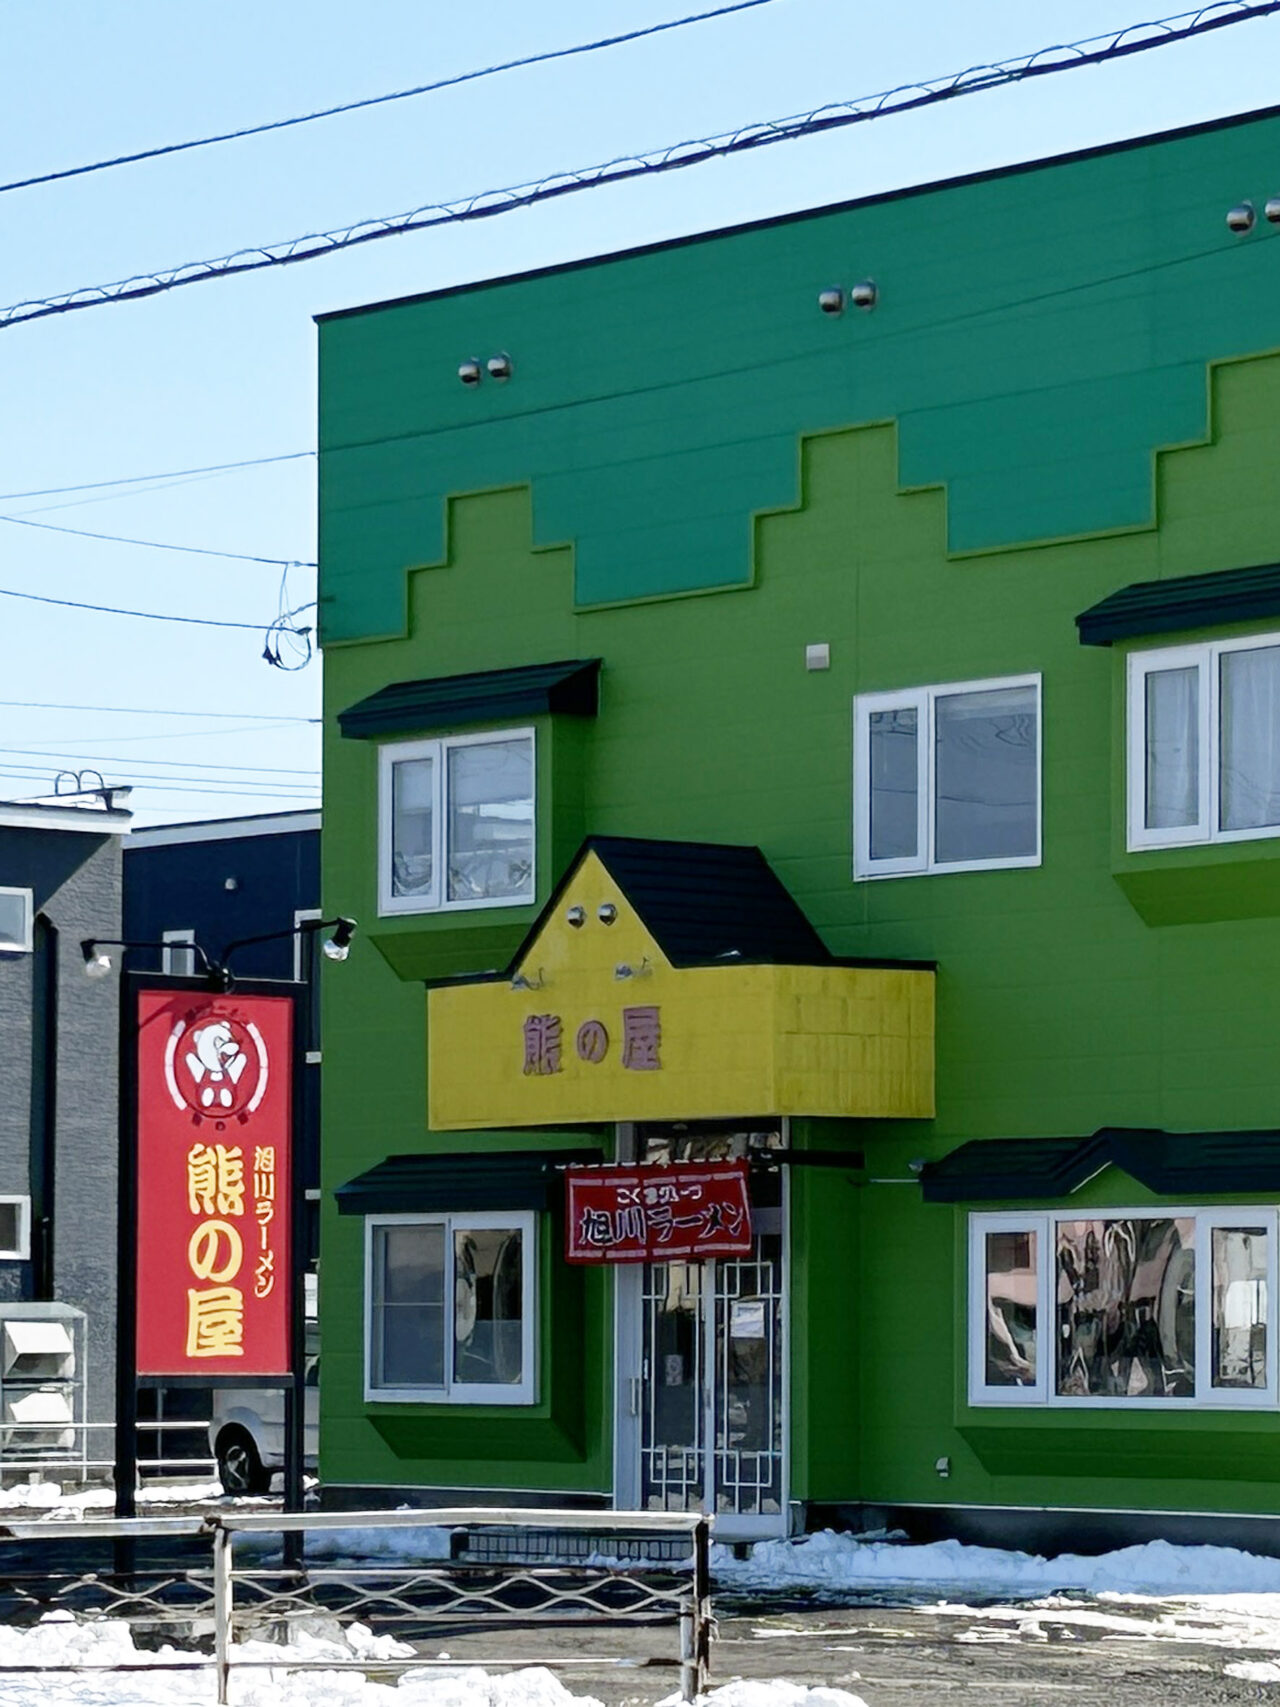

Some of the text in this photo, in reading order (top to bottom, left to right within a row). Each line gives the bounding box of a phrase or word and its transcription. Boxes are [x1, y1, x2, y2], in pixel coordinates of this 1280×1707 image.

[523, 1005, 662, 1076] 熊の屋
[186, 1142, 245, 1358] 熊の屋
[578, 1201, 744, 1247] 旭川ラーメン
